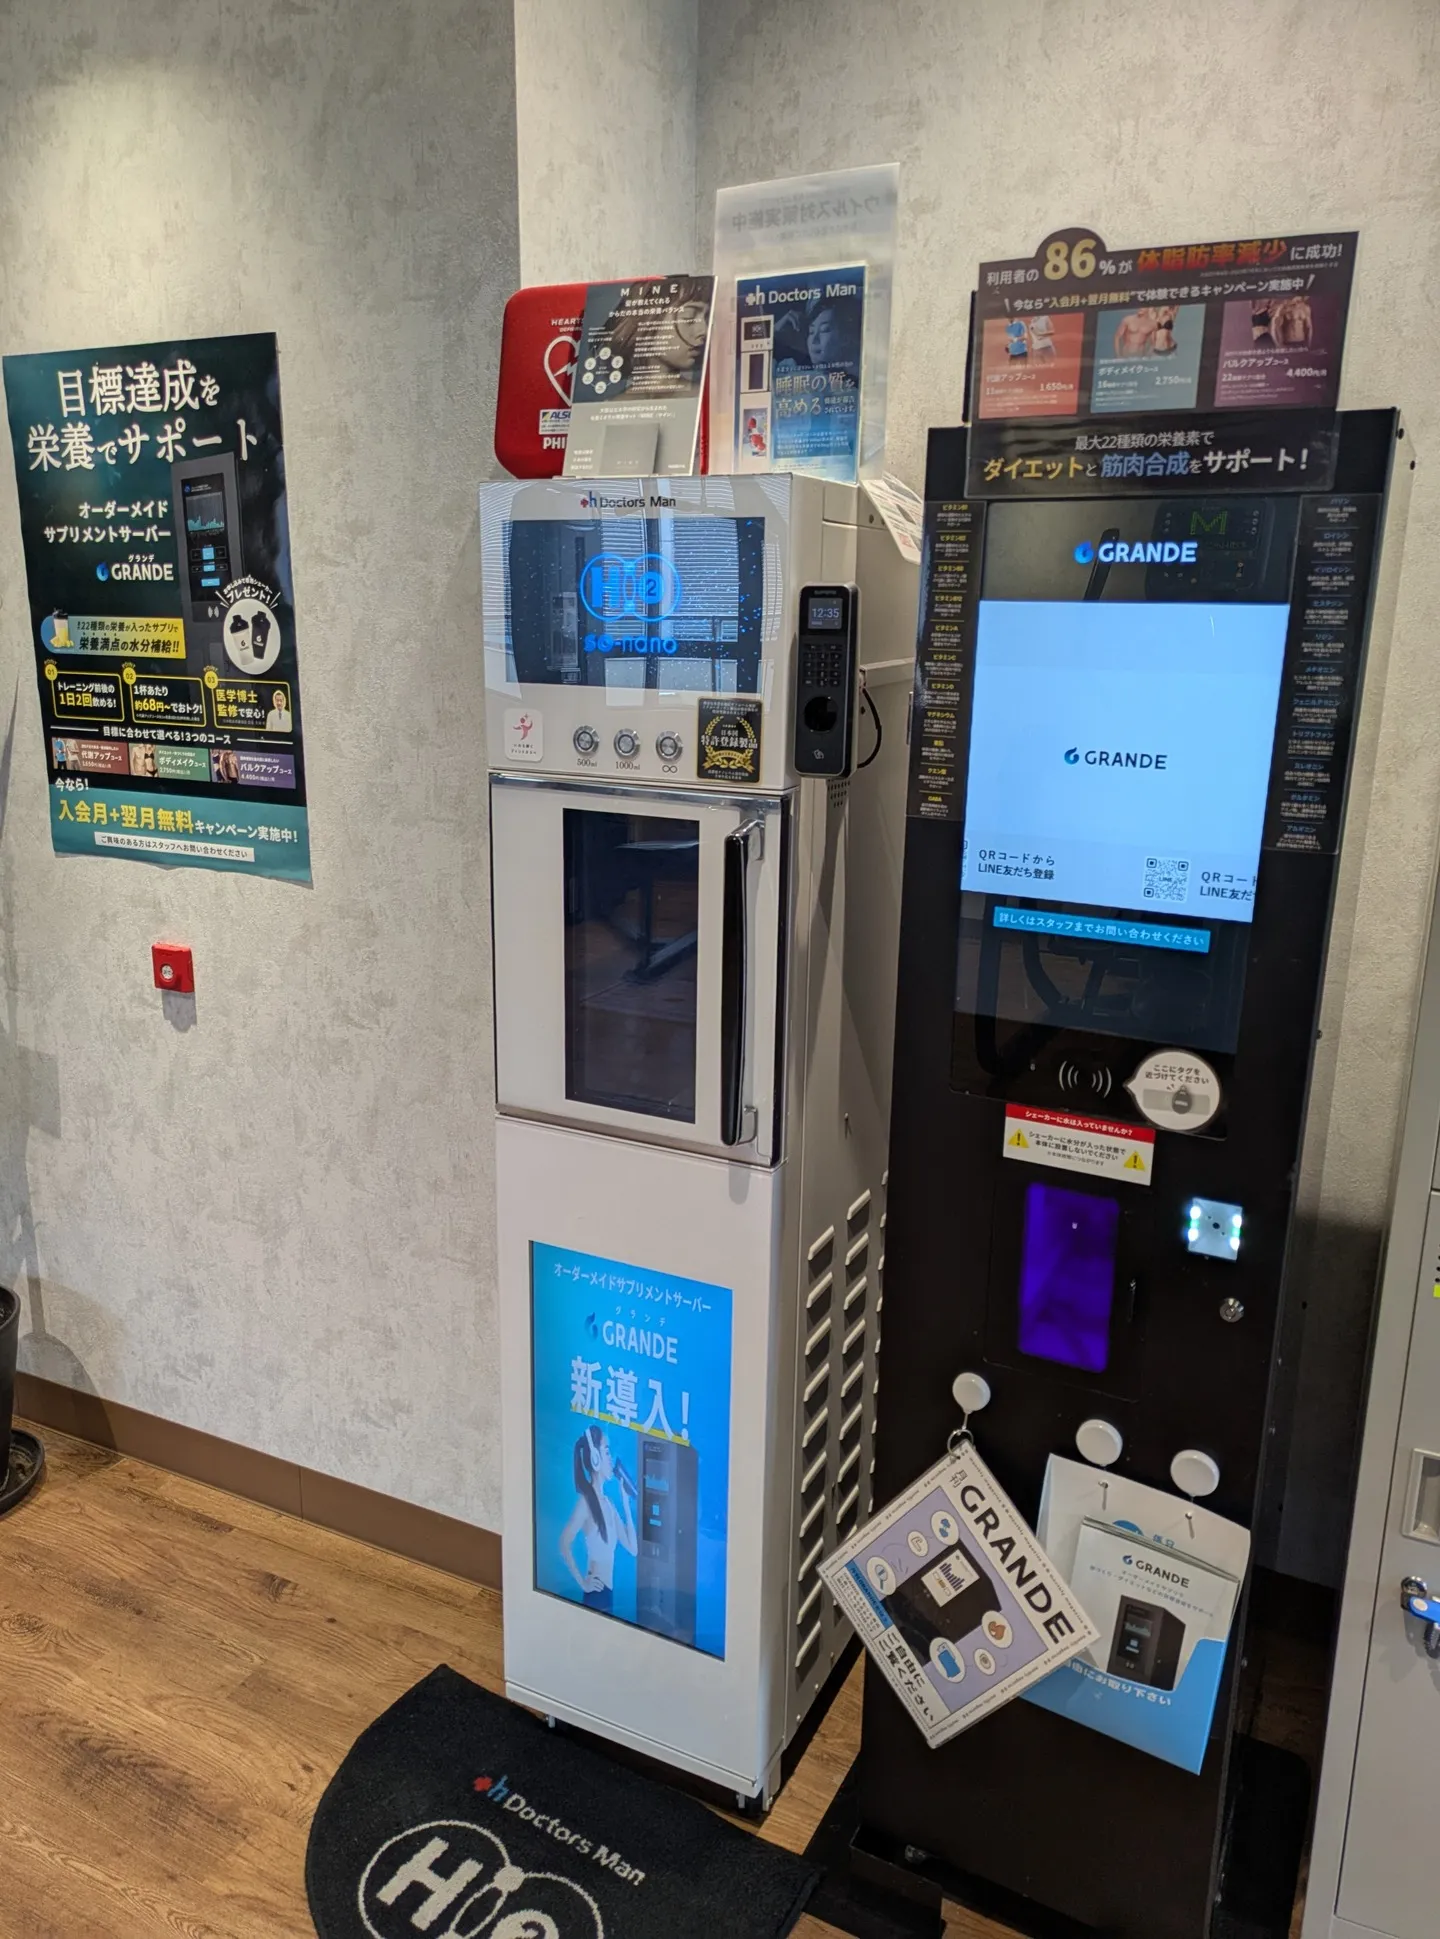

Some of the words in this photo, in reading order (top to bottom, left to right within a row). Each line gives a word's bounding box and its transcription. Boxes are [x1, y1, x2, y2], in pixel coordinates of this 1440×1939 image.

[621, 283, 678, 296] MINE
[768, 289, 821, 305] Doctors
[826, 284, 856, 298] Man
[57, 359, 221, 417] 目標達成を
[27, 417, 258, 472] 栄養でサポート
[543, 436, 567, 450] PHI
[1074, 430, 1215, 451] 最大22種類の栄養素で
[78, 500, 168, 519] オーダーメイド
[600, 497, 645, 508] Doctors
[650, 496, 676, 507] Man
[43, 524, 171, 544] サプリメントサーバー
[128, 554, 155, 562] グランデ
[1099, 541, 1197, 563] GRANDE
[111, 563, 174, 581] GRANDE
[811, 608, 840, 618] 12:35
[126, 672, 134, 680] 02
[207, 676, 216, 684] 03
[57, 681, 115, 694] トレーニング前後の
[134, 685, 168, 697] 1杯あたり
[216, 689, 258, 704] 医学博士
[217, 703, 266, 719] 監修で安心!
[577, 759, 597, 767] 500ml
[615, 761, 640, 770] 1000ml
[1085, 750, 1168, 770] GRANDE
[55, 778, 89, 791] 今なら!
[979, 849, 1055, 866] QRコードから
[978, 863, 1055, 881] LINE友だち登録
[1200, 886, 1256, 901] LINE友だ
[999, 912, 1205, 946] 詳しくはスタッフまでお問い合わせください
[1145, 1071, 1209, 1084] 近づけてください
[1153, 1064, 1201, 1076] ここにタグを
[1035, 1140, 1118, 1161] 本体に設置しないでください
[554, 1262, 712, 1312] オーダーメイドサプリメントサーバー
[602, 1320, 679, 1365] GRANDE
[570, 1355, 690, 1441] 新導入!
[960, 1485, 1075, 1644] GRANDE
[1136, 1560, 1190, 1588] GRANDE
[887, 1632, 926, 1688] ご自由に
[878, 1640, 934, 1722] ご覧ください
[1066, 1659, 1171, 1706] 由にお取り下さい
[503, 1793, 594, 1854] Doctors
[592, 1845, 646, 1887] Man
